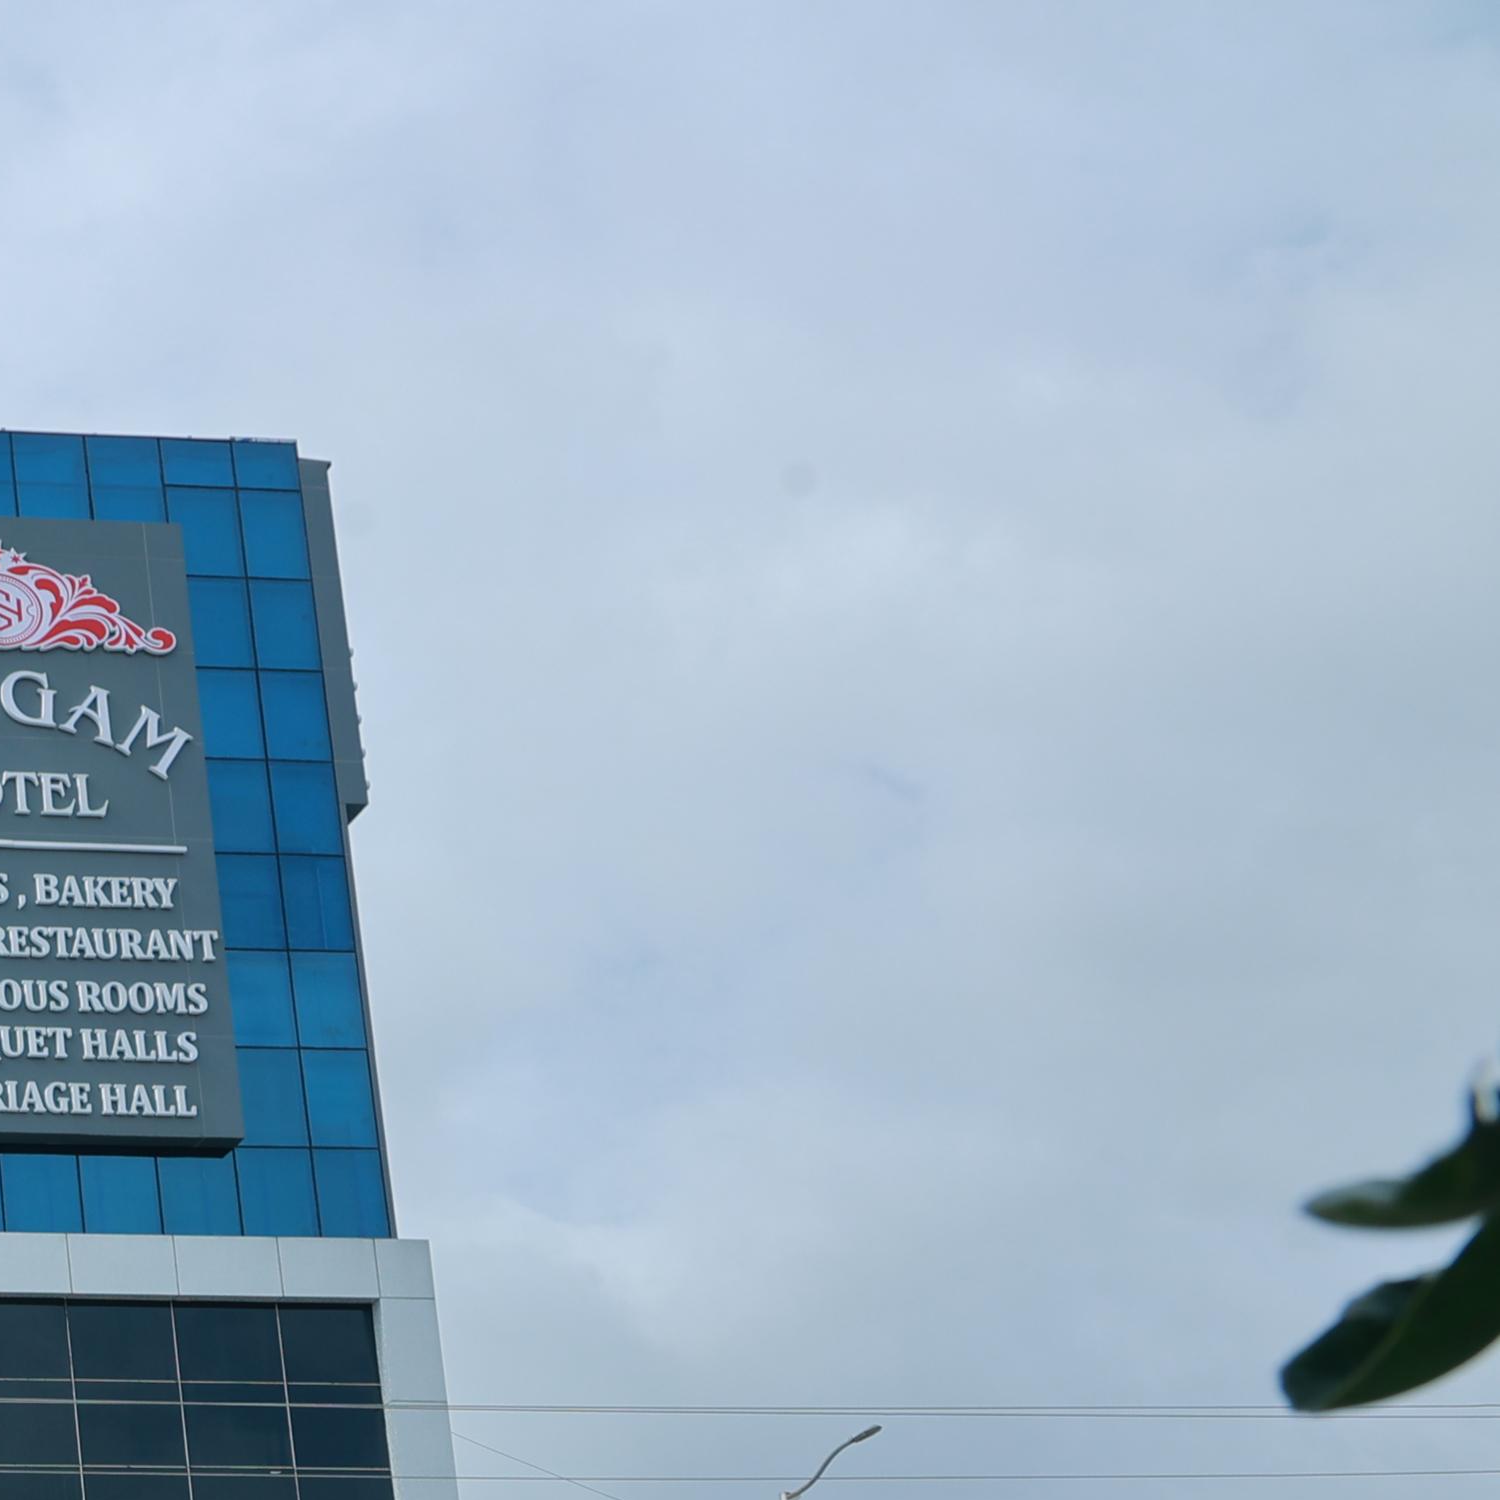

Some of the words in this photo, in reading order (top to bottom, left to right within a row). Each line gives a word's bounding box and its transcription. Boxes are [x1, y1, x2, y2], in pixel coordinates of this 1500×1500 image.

[34, 873, 177, 910] BAKERY
[78, 979, 209, 1015] ROOMS
[81, 1029, 199, 1064] HALLS
[99, 1083, 198, 1119] HALL
